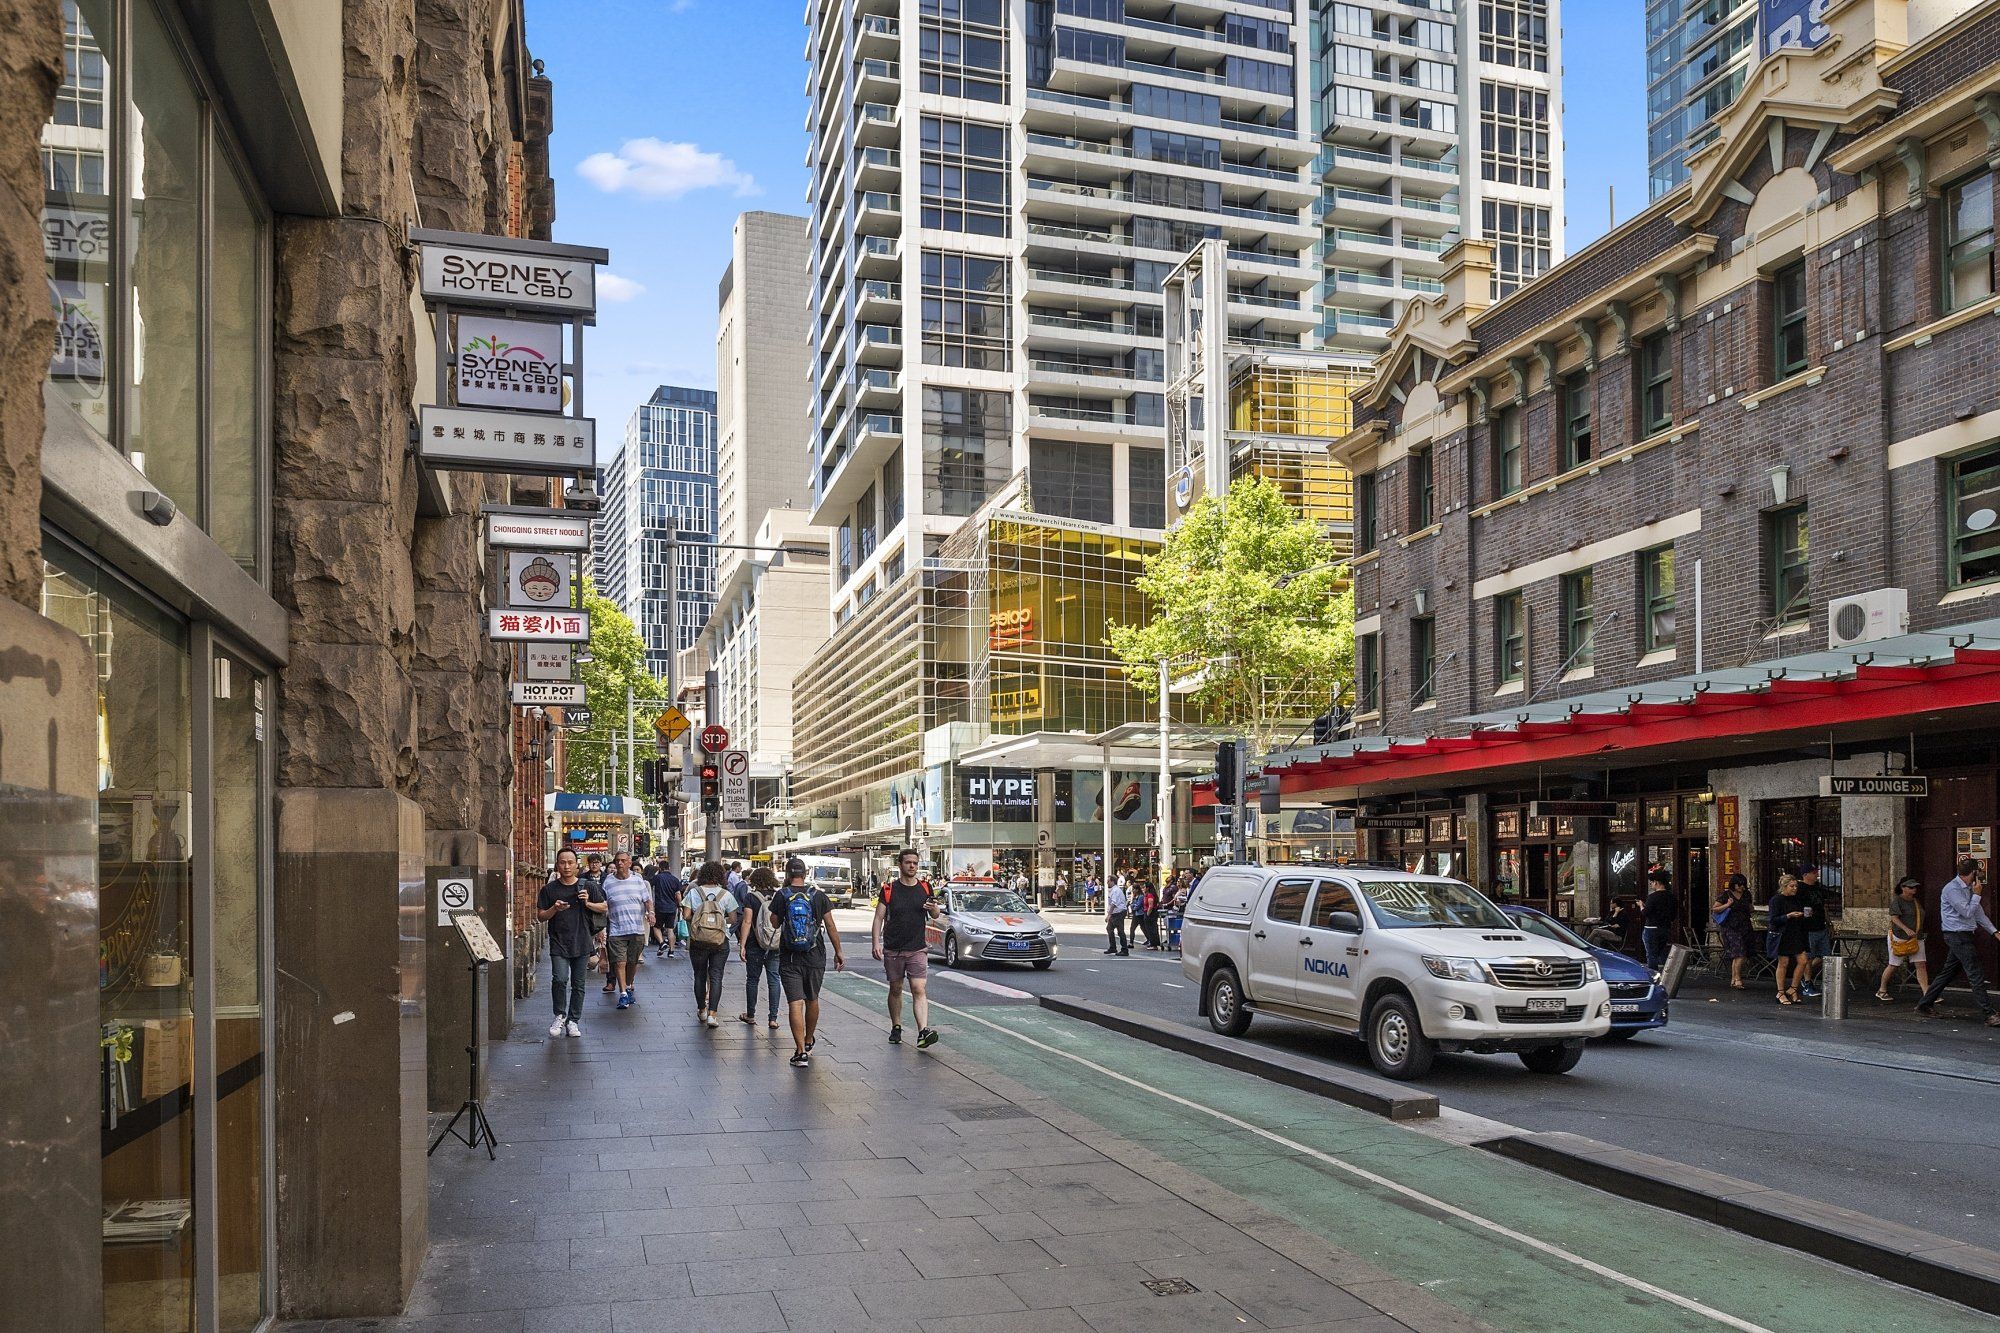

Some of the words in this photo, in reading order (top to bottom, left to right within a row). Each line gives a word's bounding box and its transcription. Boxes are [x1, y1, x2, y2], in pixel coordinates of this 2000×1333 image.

[442, 255, 572, 284] SYDNEY
[442, 275, 518, 294] HOTEL
[524, 283, 573, 299] CBD
[462, 353, 557, 374] SYDNEY
[462, 368, 518, 382] HOTEL
[522, 373, 558, 385] CBD
[493, 525, 532, 535] CHONGQING
[533, 527, 558, 536] STREET
[559, 529, 584, 537] NOODLE
[523, 685, 548, 695] HOT
[551, 686, 575, 696] POT
[567, 712, 590, 721] VIP
[704, 733, 727, 744] STOP
[729, 777, 743, 787] NO
[970, 778, 1033, 796] HYPE
[1833, 780, 1855, 792] VIP
[1859, 780, 1909, 792] LOUNGE
[577, 799, 600, 810] ANZ
[1004, 798, 1032, 806] Limited.
[1723, 802, 1735, 875] BOTTLE
[1304, 957, 1350, 979] NOKIA
